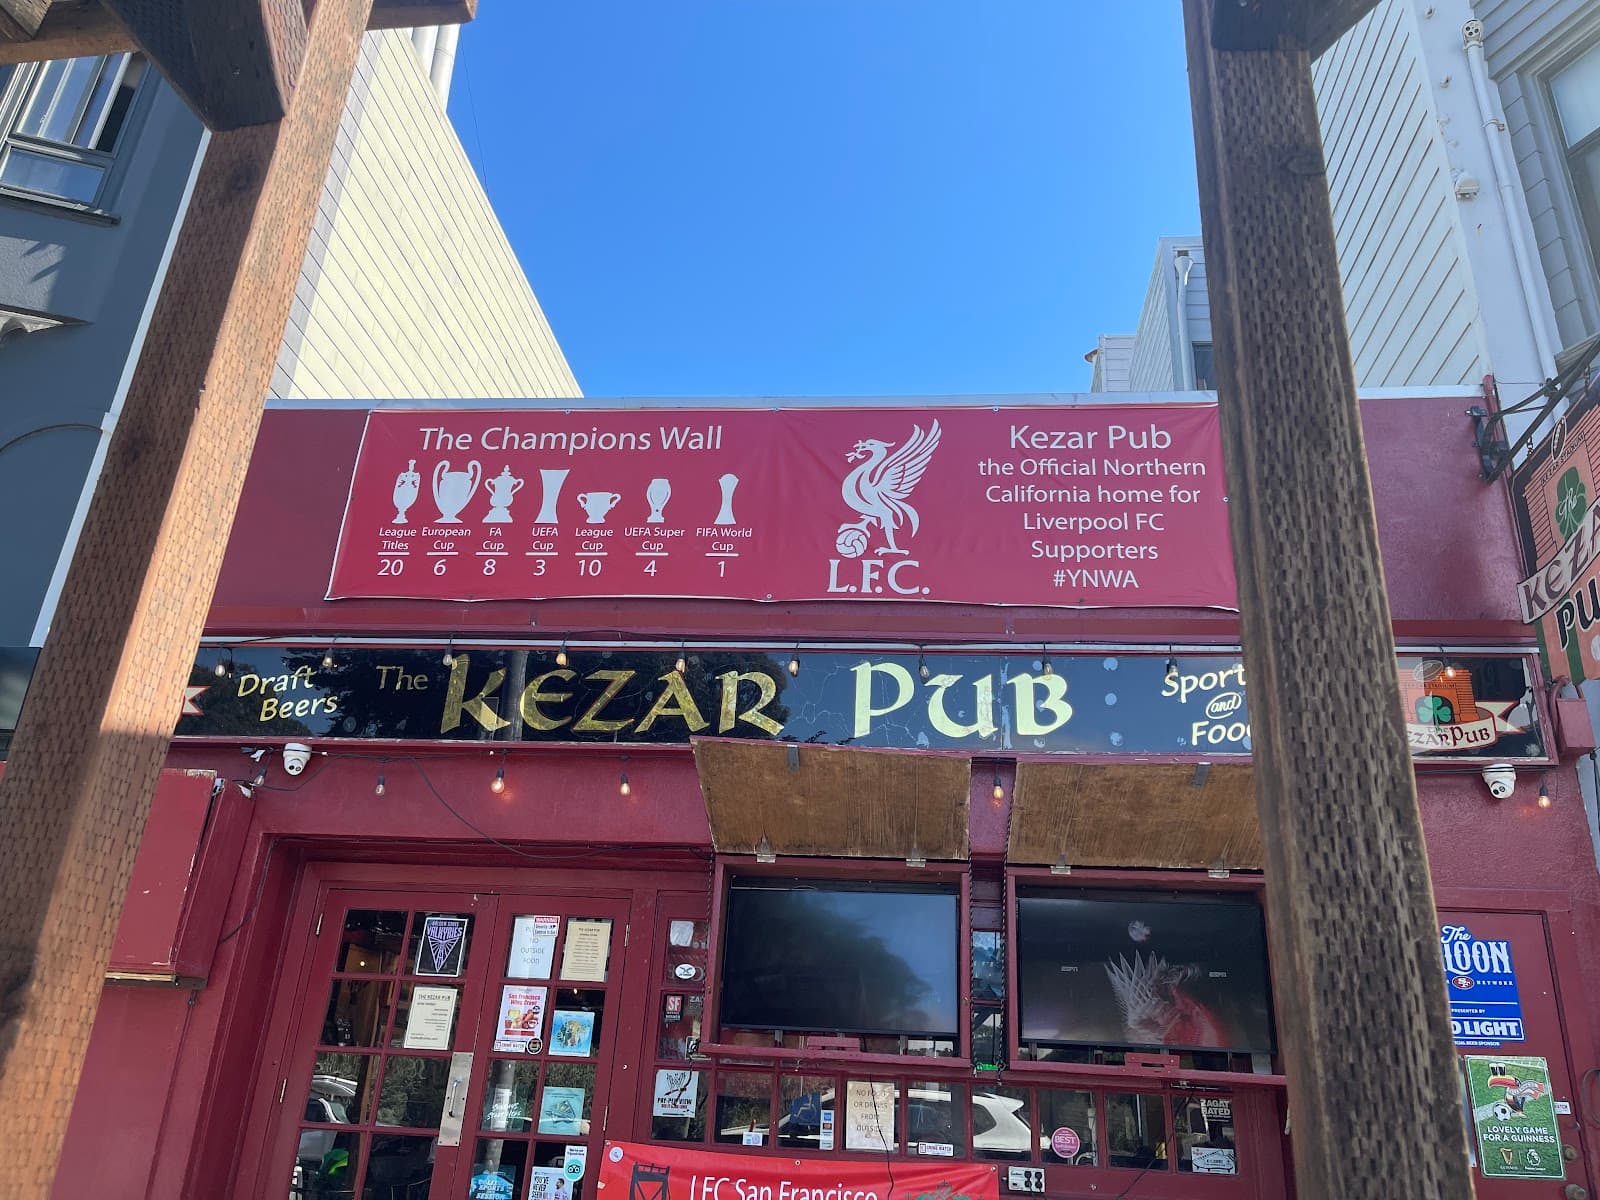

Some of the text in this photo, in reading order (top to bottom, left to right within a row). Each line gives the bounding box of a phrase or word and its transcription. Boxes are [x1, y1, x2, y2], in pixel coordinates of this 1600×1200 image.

[420, 426, 722, 455] The Champions Wall
[1009, 425, 1171, 449] Kezar Pub
[978, 458, 1206, 476] the Official Northern
[986, 485, 1201, 503] California home for
[1024, 513, 1165, 535] Liverpool FC
[379, 527, 417, 539] League
[422, 527, 471, 539] European
[489, 527, 503, 538] FA
[532, 527, 559, 538] UEFA
[575, 527, 614, 539] League
[624, 527, 685, 539] UEFA Super
[696, 528, 752, 539] FIFA World
[381, 540, 409, 551] Titles
[433, 540, 454, 553] Cup
[482, 540, 504, 553] Cup
[532, 540, 554, 553] Cup
[582, 540, 603, 553] Cup
[642, 540, 664, 553] Cup
[712, 541, 734, 554] Cup
[1031, 541, 1159, 563] Supporters
[377, 560, 404, 576] 20
[433, 560, 446, 576] 6
[482, 560, 496, 576] 8
[533, 560, 546, 576] 3
[578, 560, 602, 576] 10
[643, 560, 657, 577] 4
[717, 561, 726, 577] 1
[1523, 505, 1600, 619] KEZA
[827, 560, 930, 594] L.F.C.
[1053, 570, 1139, 588] #YNWA
[1556, 576, 1600, 650] PU
[237, 666, 317, 698] Draft
[1161, 664, 1247, 703] Sport
[376, 654, 1074, 738] The KEZAR PUB
[259, 693, 338, 722] Beers
[1407, 730, 1450, 746] EZAR
[427, 926, 463, 940] VALKYRIES
[1441, 925, 1472, 944] The
[1443, 941, 1512, 975] LOON
[668, 997, 680, 1011] SF
[1464, 1021, 1520, 1036] LIGHT
[856, 1089, 866, 1097] NO
[853, 1101, 863, 1109] OR
[1200, 1099, 1230, 1108] ZAGAT
[1201, 1107, 1231, 1116] RATED
[1487, 1126, 1548, 1135] LOVELY GAME
[1511, 1134, 1555, 1143] GUINNESS
[1055, 1135, 1076, 1144] BEST
[690, 1175, 878, 1200] LFC San Francisco
